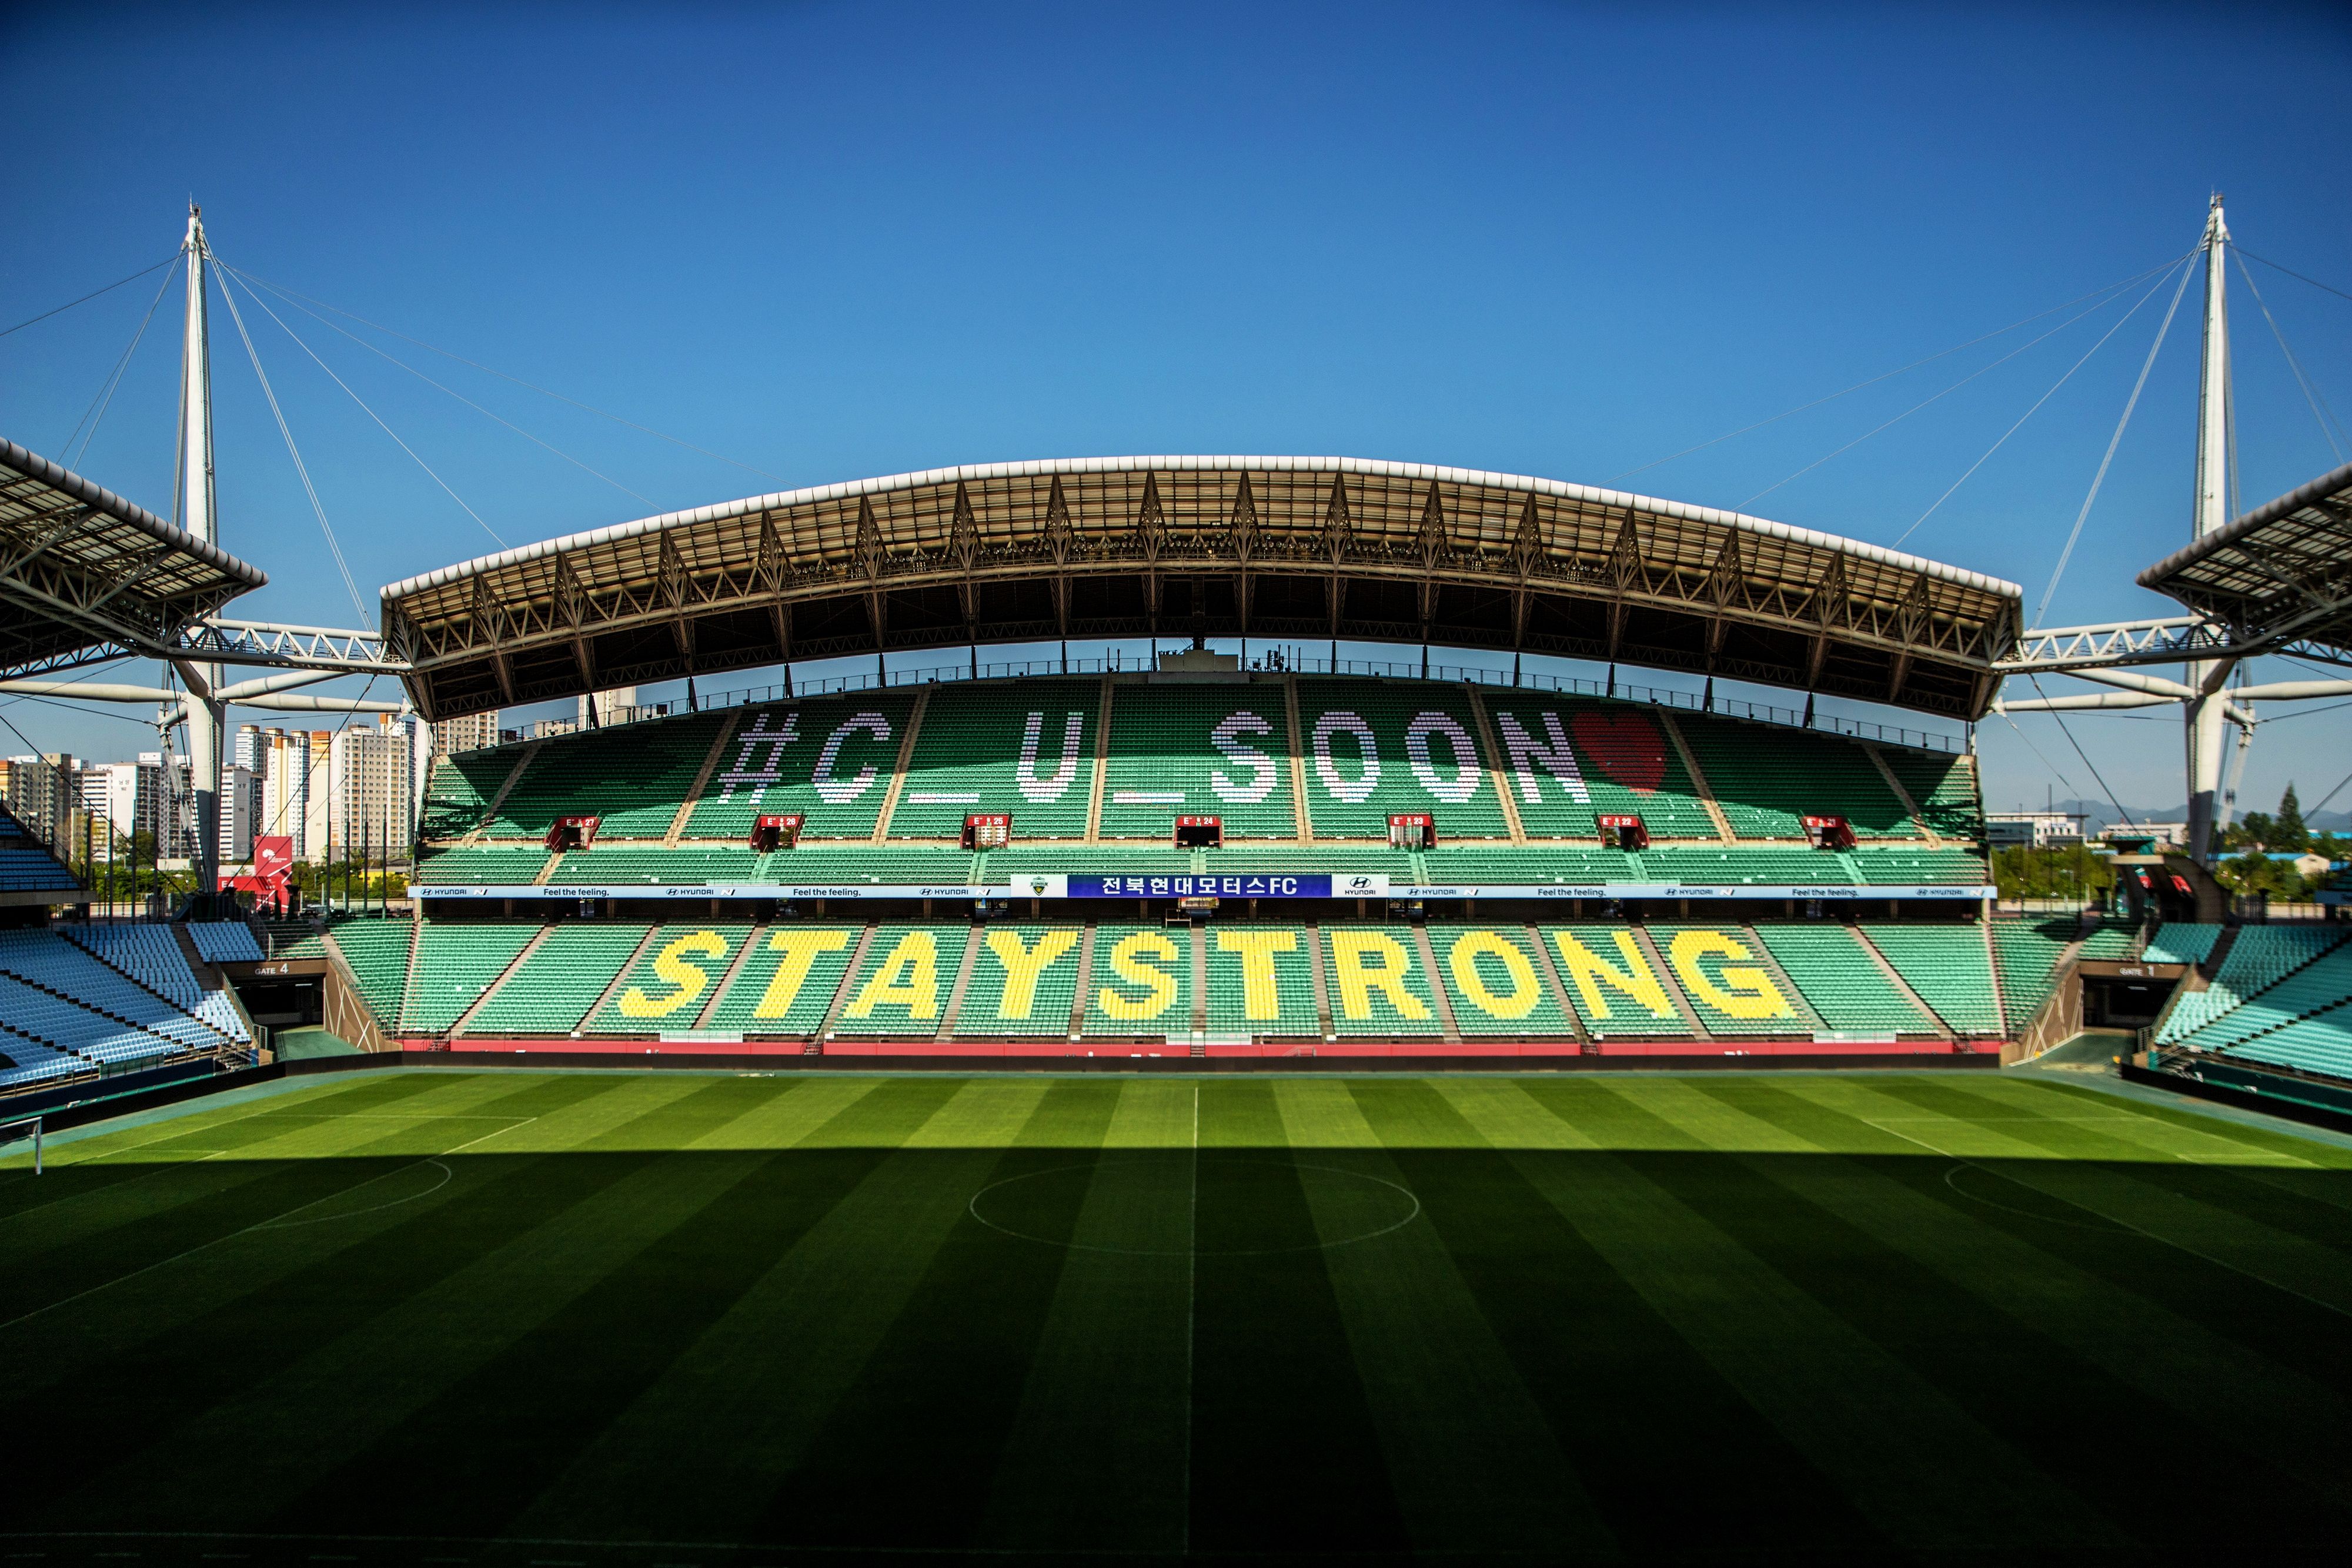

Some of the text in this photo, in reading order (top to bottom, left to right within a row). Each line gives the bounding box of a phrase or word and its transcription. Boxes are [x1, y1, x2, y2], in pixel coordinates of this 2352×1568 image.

[1102, 877, 1297, 894] 전북현대모터스FC
[579, 889, 609, 897] feeling.
[829, 889, 861, 897] feeling.
[1573, 889, 1606, 897] feeling.
[280, 963, 289, 974] 4
[2147, 965, 2154, 976] 1
